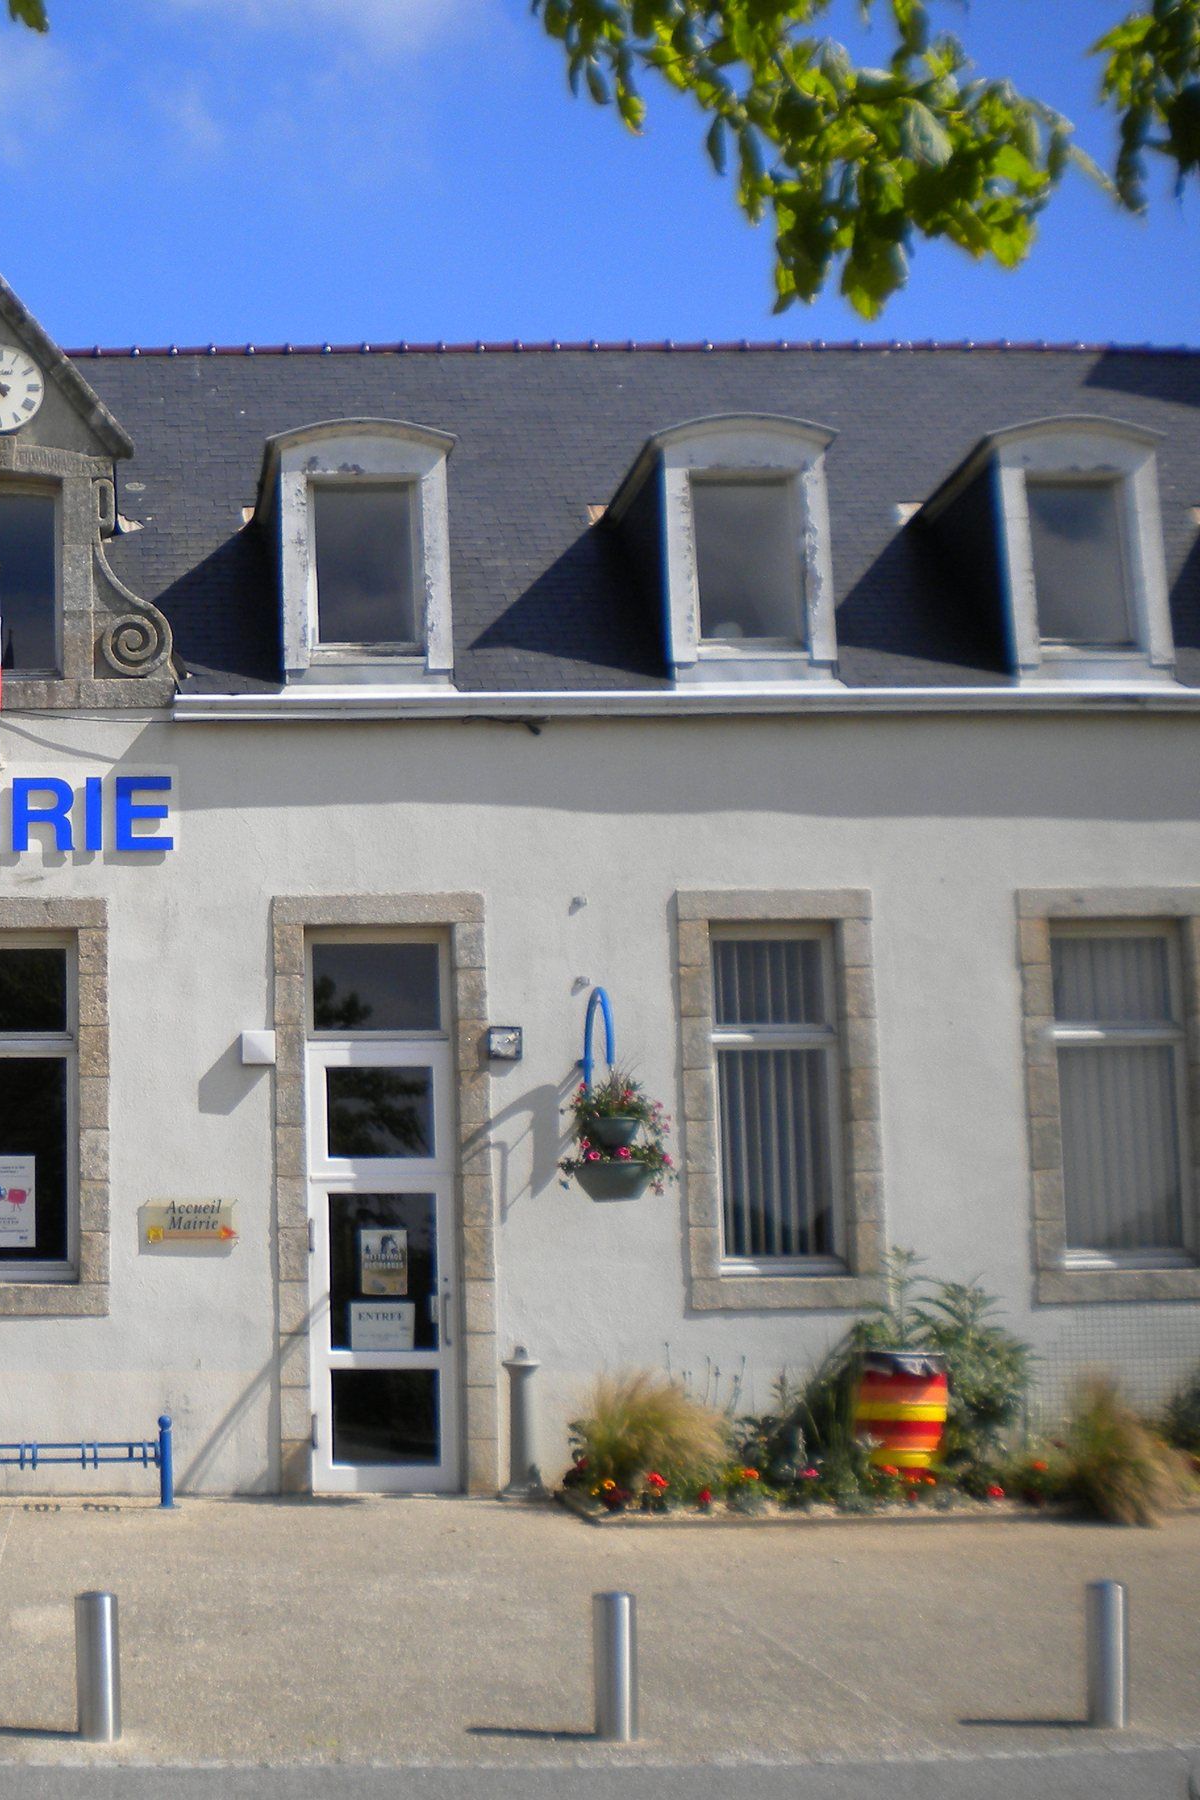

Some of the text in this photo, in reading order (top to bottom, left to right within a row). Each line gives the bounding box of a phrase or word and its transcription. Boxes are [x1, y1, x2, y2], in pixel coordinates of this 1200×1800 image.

[165, 1199, 222, 1215] Accueil
[168, 1216, 219, 1231] Mairie
[358, 1311, 404, 1321] ENTREE
